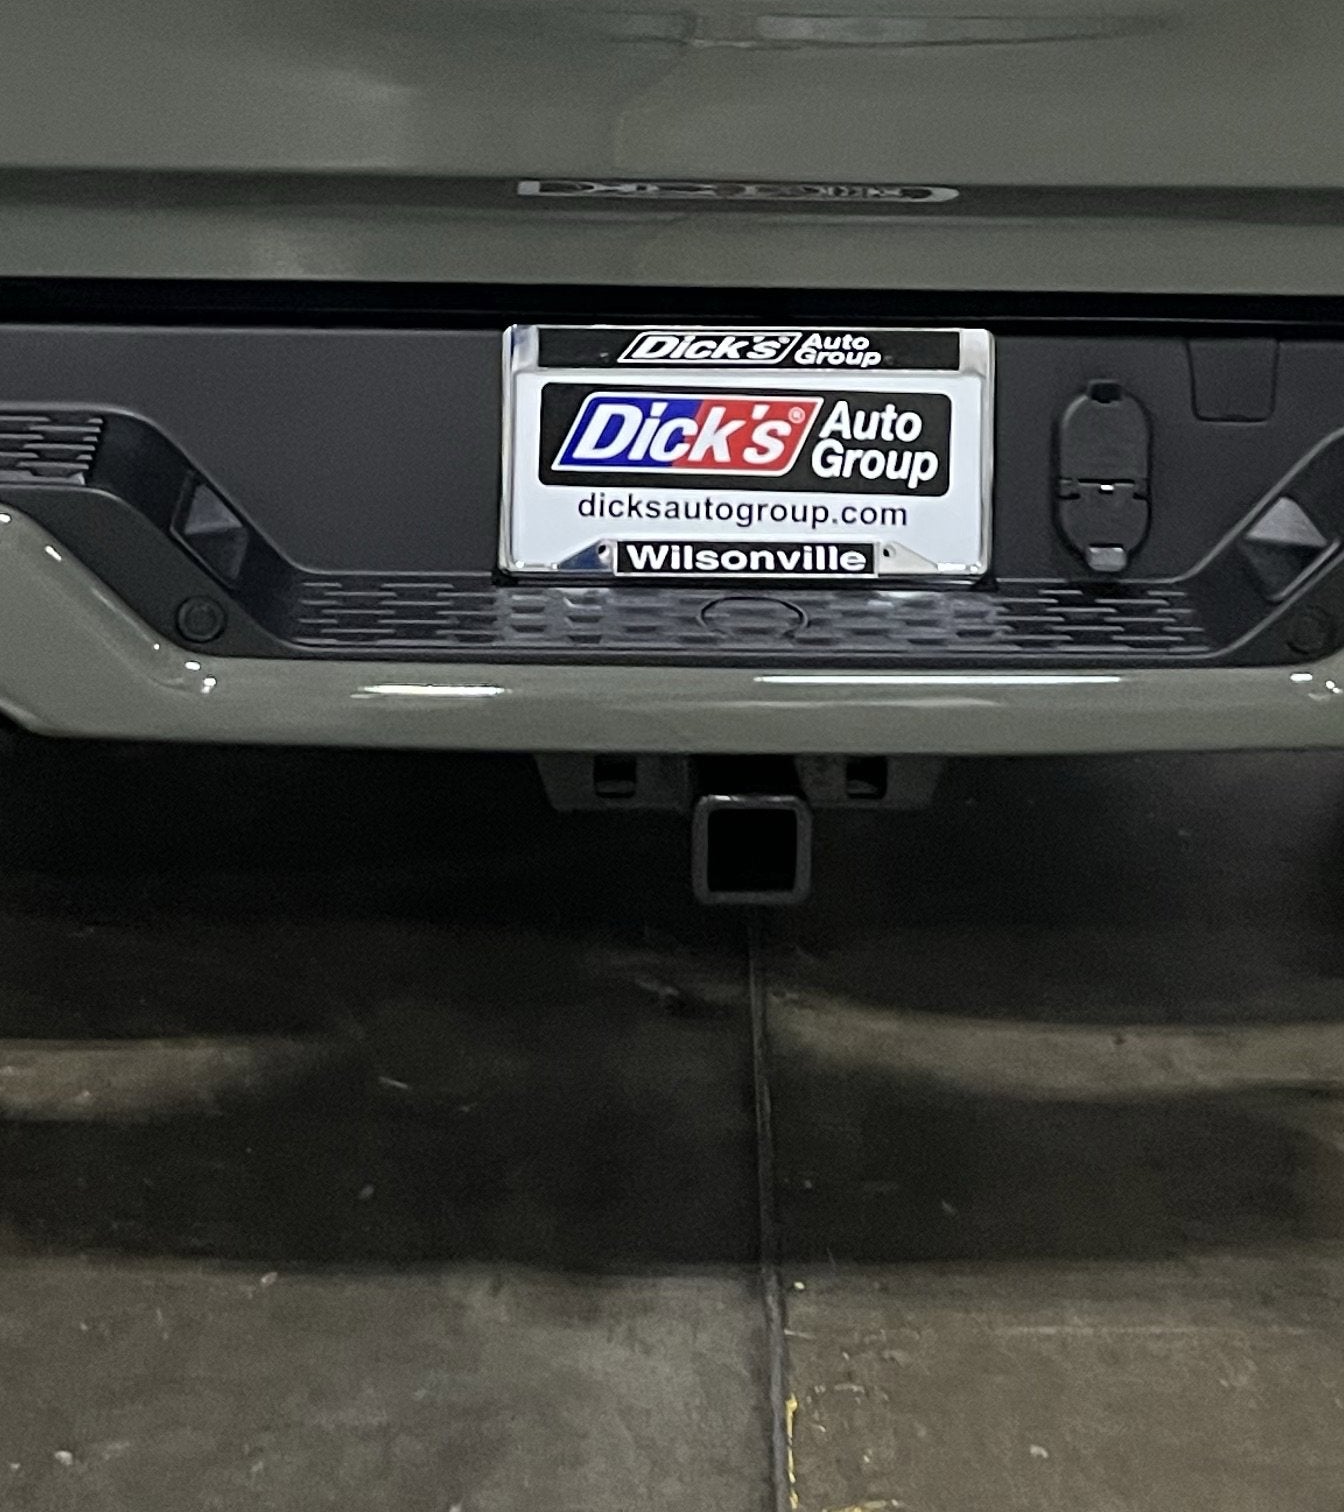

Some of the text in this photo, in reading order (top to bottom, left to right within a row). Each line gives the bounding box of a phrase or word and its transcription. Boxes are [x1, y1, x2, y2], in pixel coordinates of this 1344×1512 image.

[802, 333, 869, 350] Auto
[794, 348, 882, 368] Group
[819, 400, 922, 443] Auto
[812, 442, 938, 489] Group
[578, 493, 908, 529] dicksautogroup.com
[627, 544, 867, 572] Wilsonville
